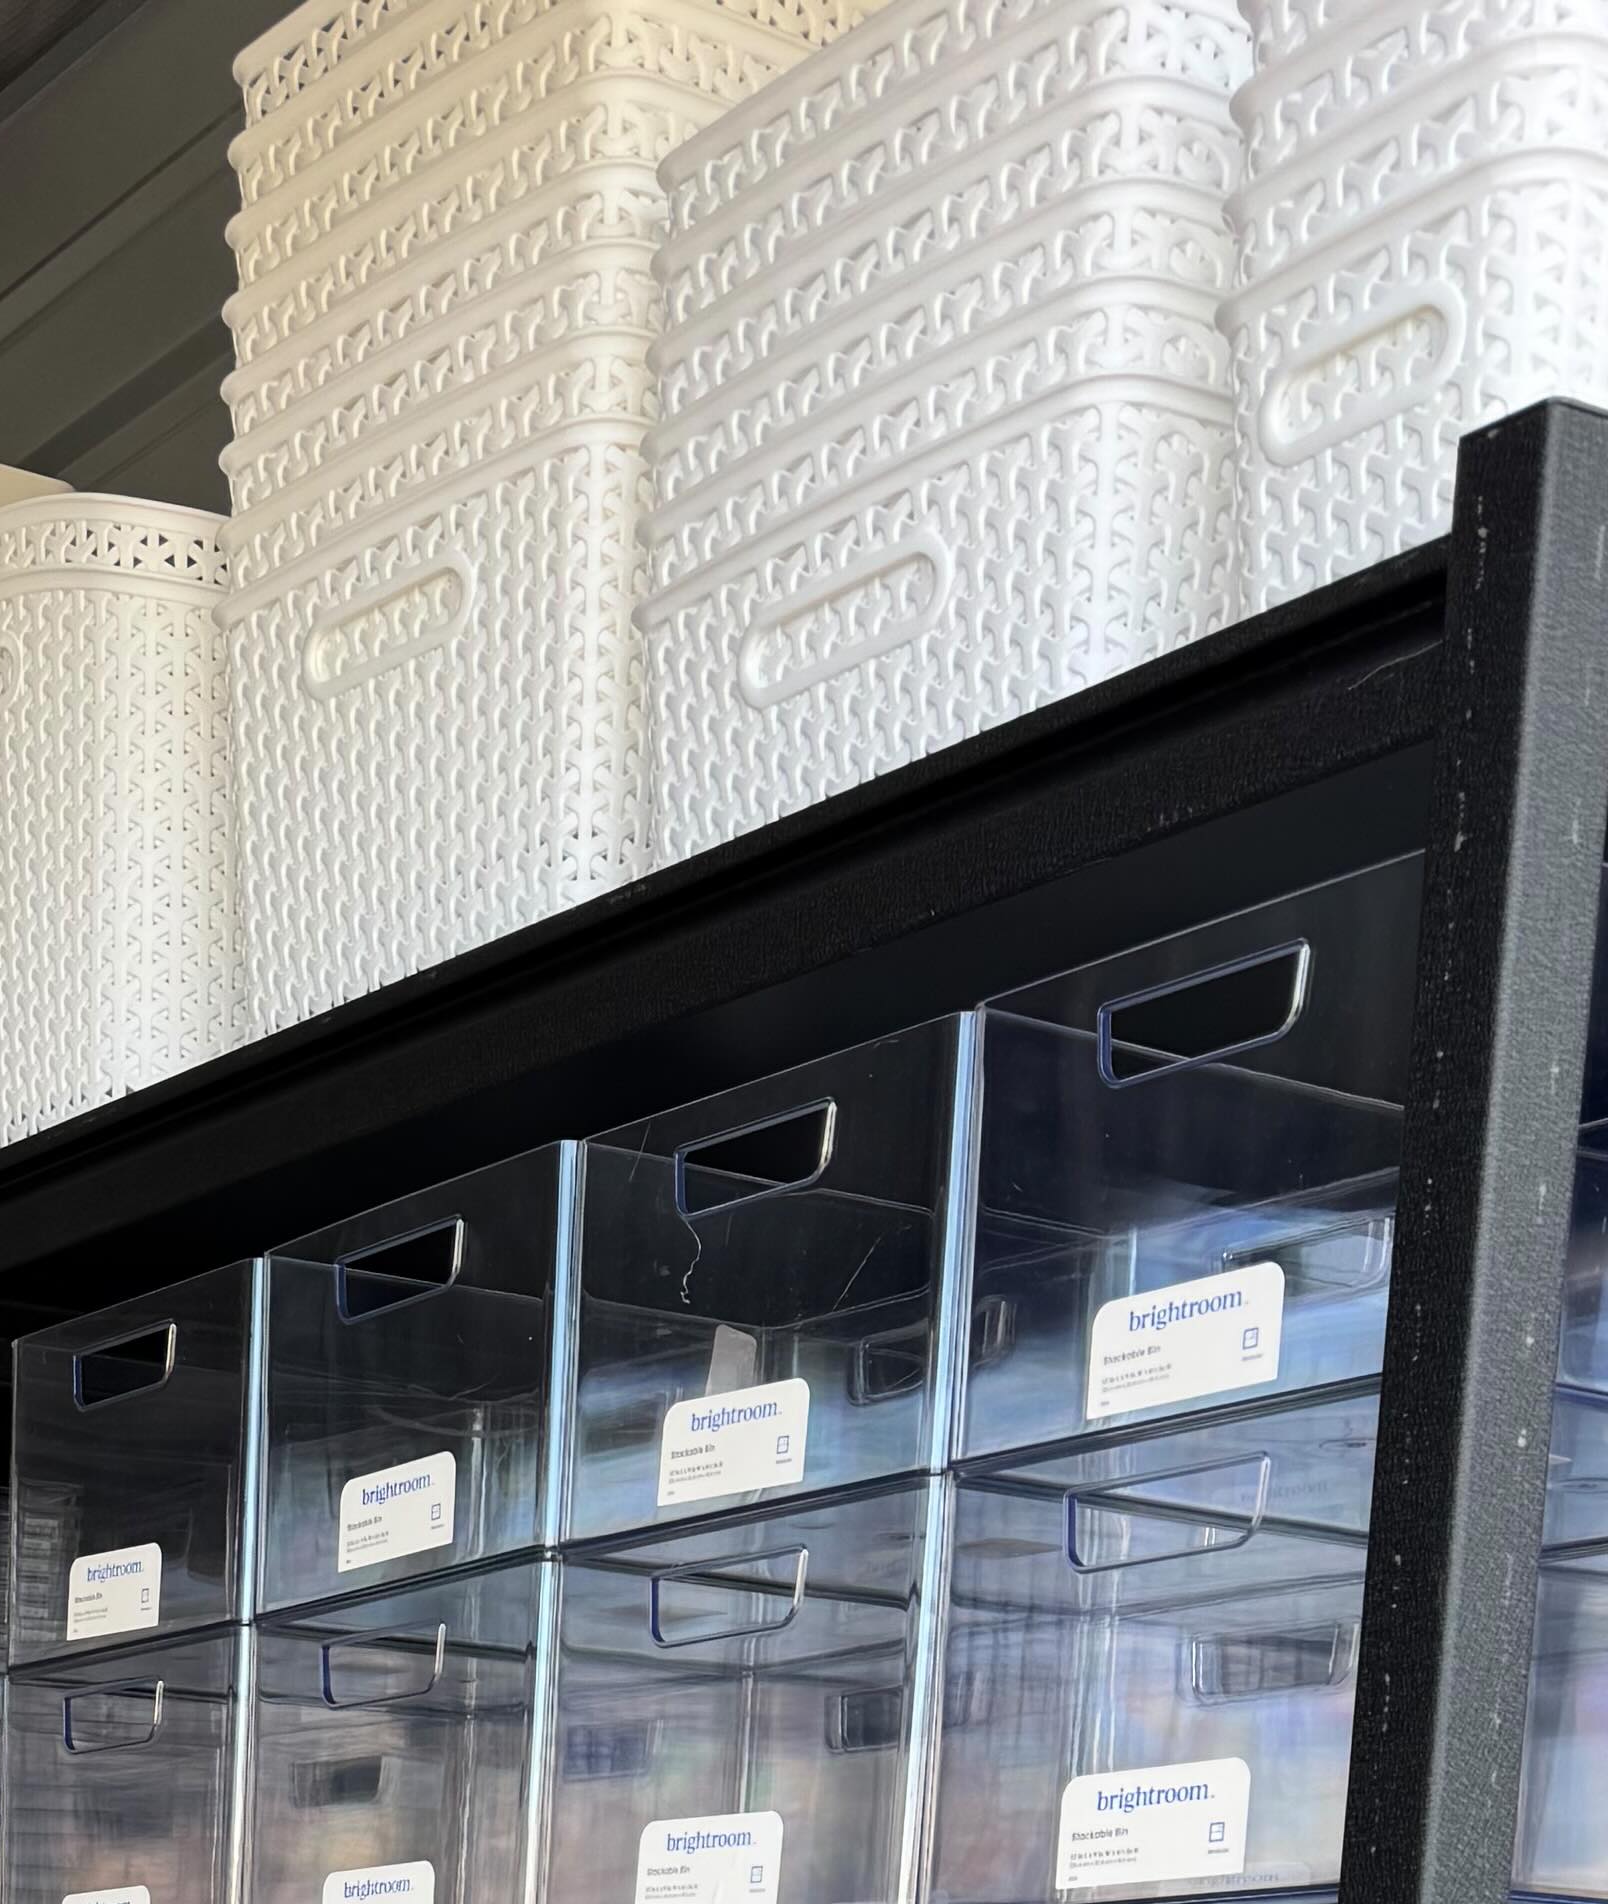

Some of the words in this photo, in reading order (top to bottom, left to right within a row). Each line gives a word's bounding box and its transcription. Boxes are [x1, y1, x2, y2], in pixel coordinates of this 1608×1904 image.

[1129, 1291, 1242, 1331] brightroom
[691, 1401, 777, 1432] brightroom
[362, 1474, 431, 1505] brightroom
[1096, 1783, 1209, 1813] brightroom
[667, 1831, 751, 1854] brightroom
